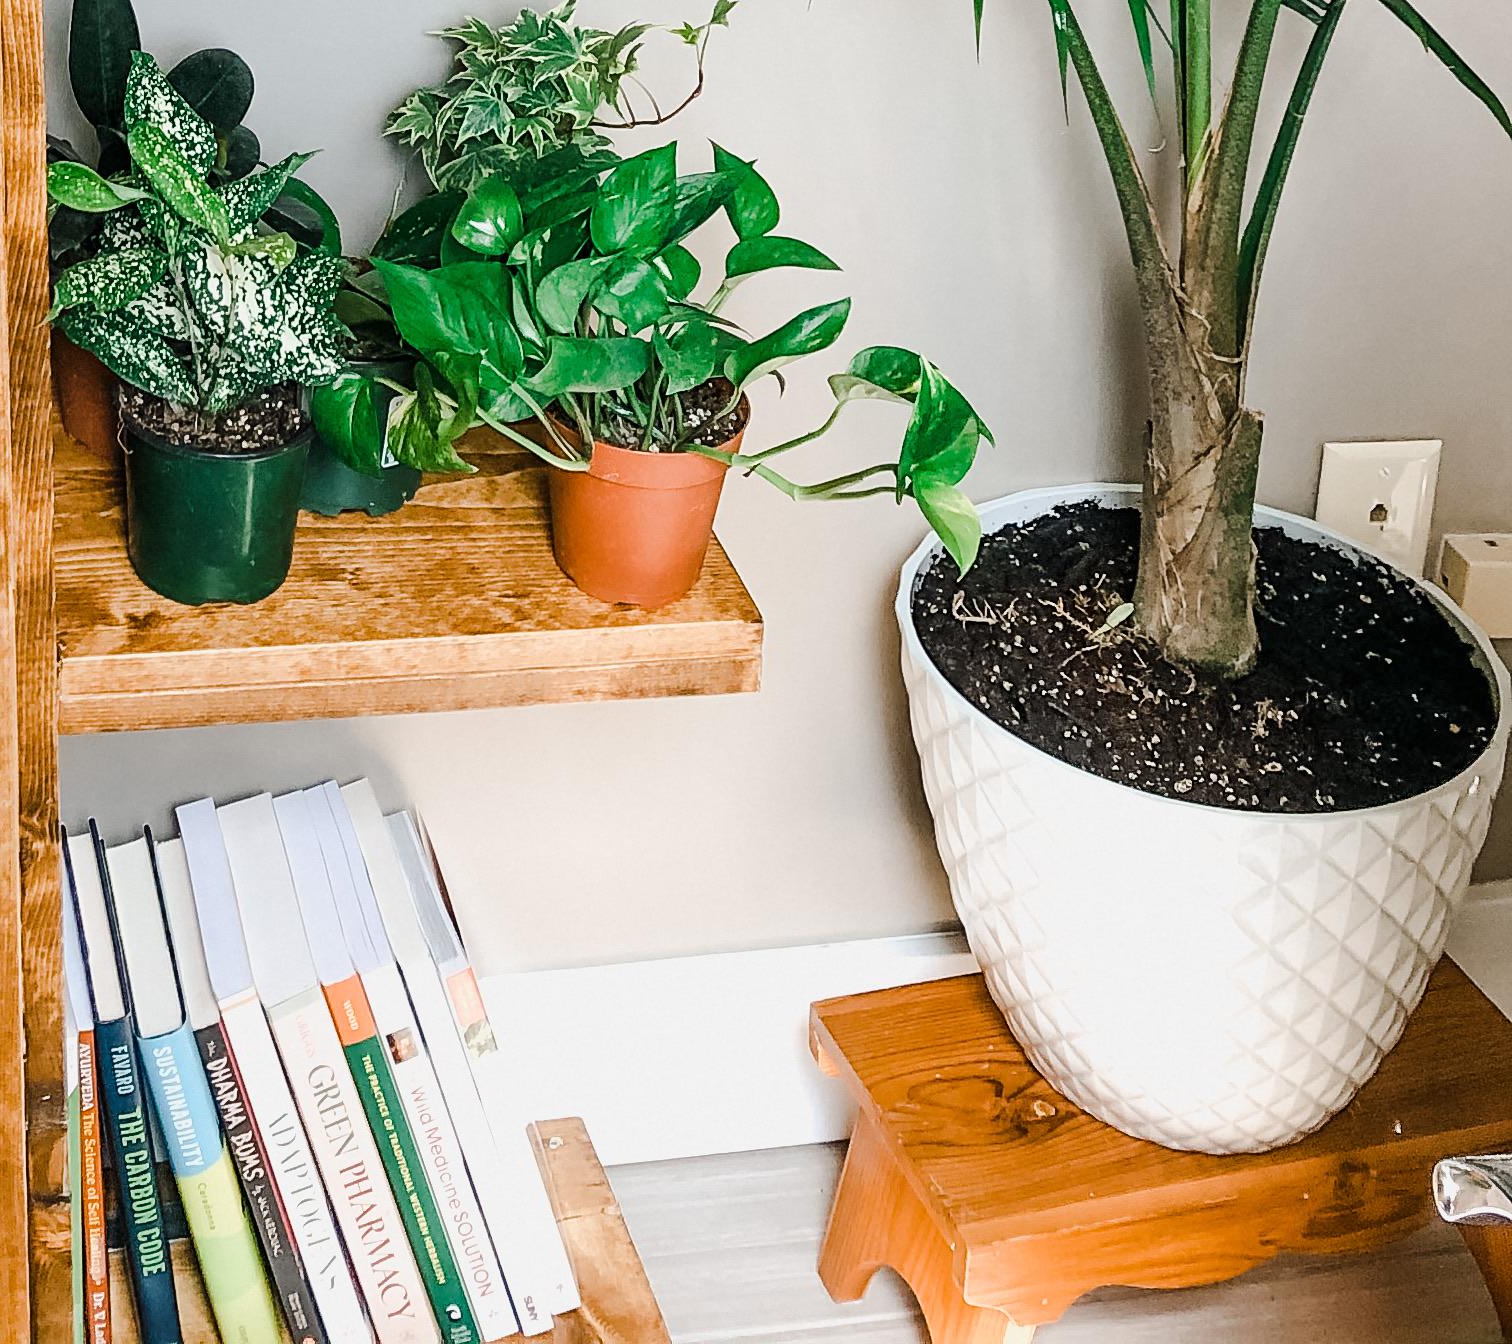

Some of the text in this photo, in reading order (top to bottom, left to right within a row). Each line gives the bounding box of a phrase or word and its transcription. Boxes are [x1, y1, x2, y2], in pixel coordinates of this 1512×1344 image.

[343, 1000, 359, 1031] WOOD
[79, 1043, 93, 1112] AYURVEDA
[153, 1046, 204, 1167] SUSTAINABILITY
[82, 1111, 96, 1136] The
[206, 1057, 247, 1130] DHARMA
[230, 1130, 265, 1182] BUMS
[84, 1138, 97, 1185] Science
[87, 1185, 99, 1200] of
[111, 1045, 165, 1277] FAVARO THE CARBON CODE
[308, 1065, 416, 1318] GREEN PHARMACY
[361, 1054, 446, 1285] THE PRACTICE OF TRADITIONAL WESTERN HERBALISM
[410, 1087, 432, 1124] Wild
[425, 1126, 461, 1209] Medicine
[453, 1211, 494, 1297] SOLUTION
[88, 1202, 101, 1226] Self
[197, 1182, 216, 1230] Caradonna
